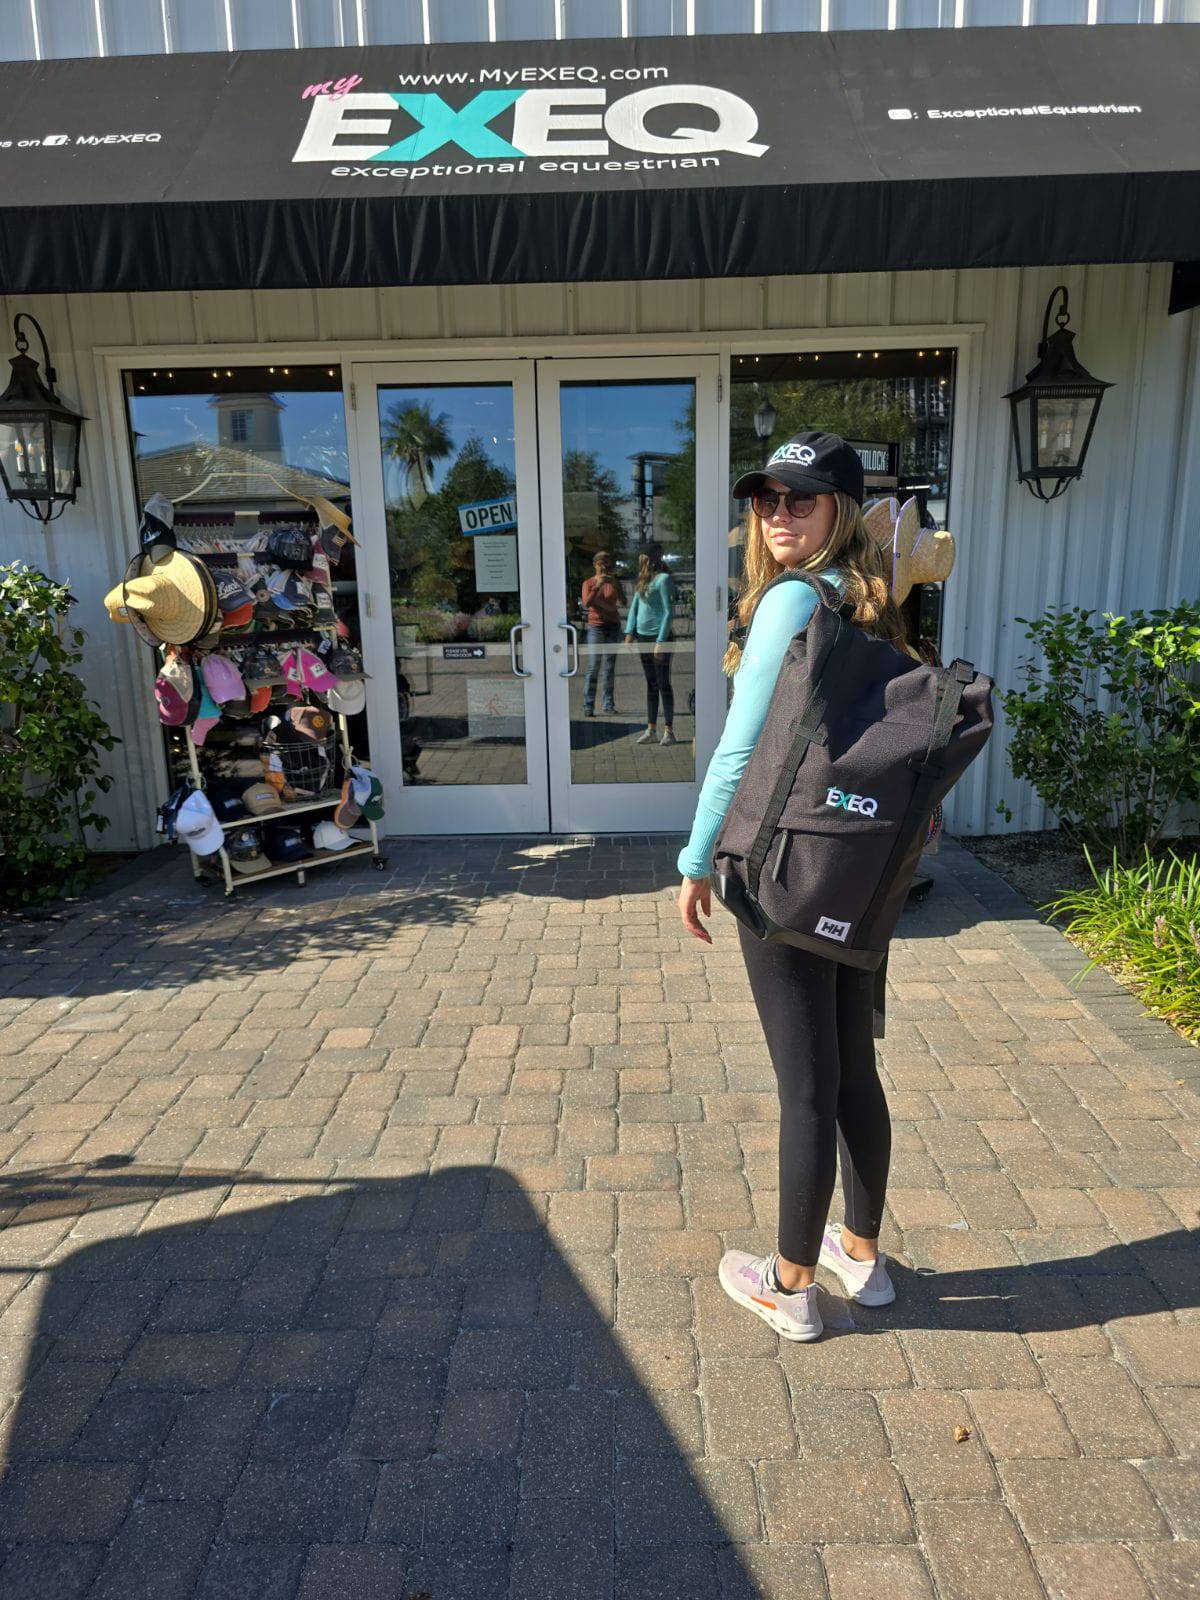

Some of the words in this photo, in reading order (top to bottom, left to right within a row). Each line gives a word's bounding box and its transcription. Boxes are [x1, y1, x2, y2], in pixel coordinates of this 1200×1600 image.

[301, 75, 363, 100] my
[398, 66, 669, 86] www.MyEXEQ.com
[292, 84, 770, 162] EXEQ
[927, 104, 1142, 119] ExceptionalEquestrian
[76, 133, 162, 146] MyEXEQ
[331, 161, 525, 180] exceptional
[538, 156, 721, 173] equestrian
[465, 502, 513, 529] OPEN
[826, 787, 878, 818] EXEQ
[821, 921, 845, 936] HH
